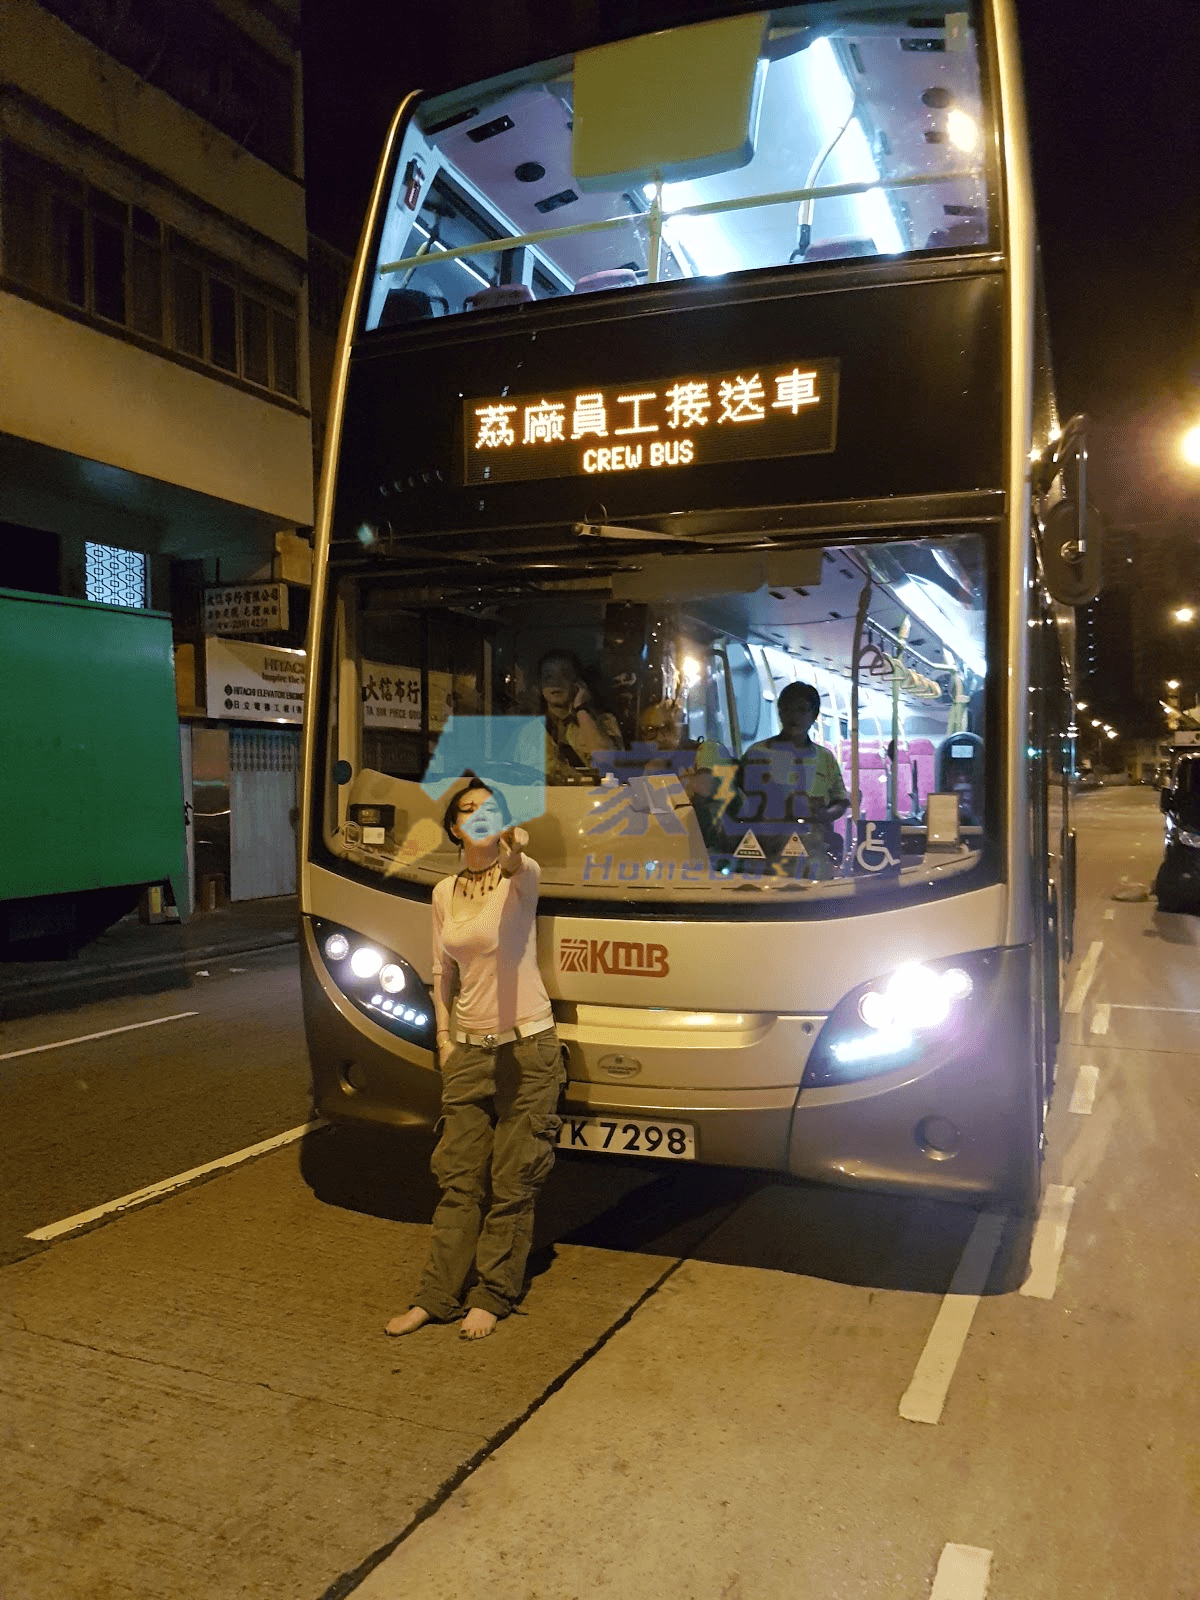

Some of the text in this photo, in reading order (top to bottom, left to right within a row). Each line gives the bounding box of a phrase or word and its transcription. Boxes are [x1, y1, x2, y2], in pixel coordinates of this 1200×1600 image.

[474, 367, 821, 449] 荔廠員工接送車
[583, 439, 695, 474] CREW BUS
[234, 686, 256, 697] HITACHI
[257, 688, 286, 700] ELEVATOR
[591, 938, 670, 978] KMB
[599, 1122, 687, 1156] 7298
